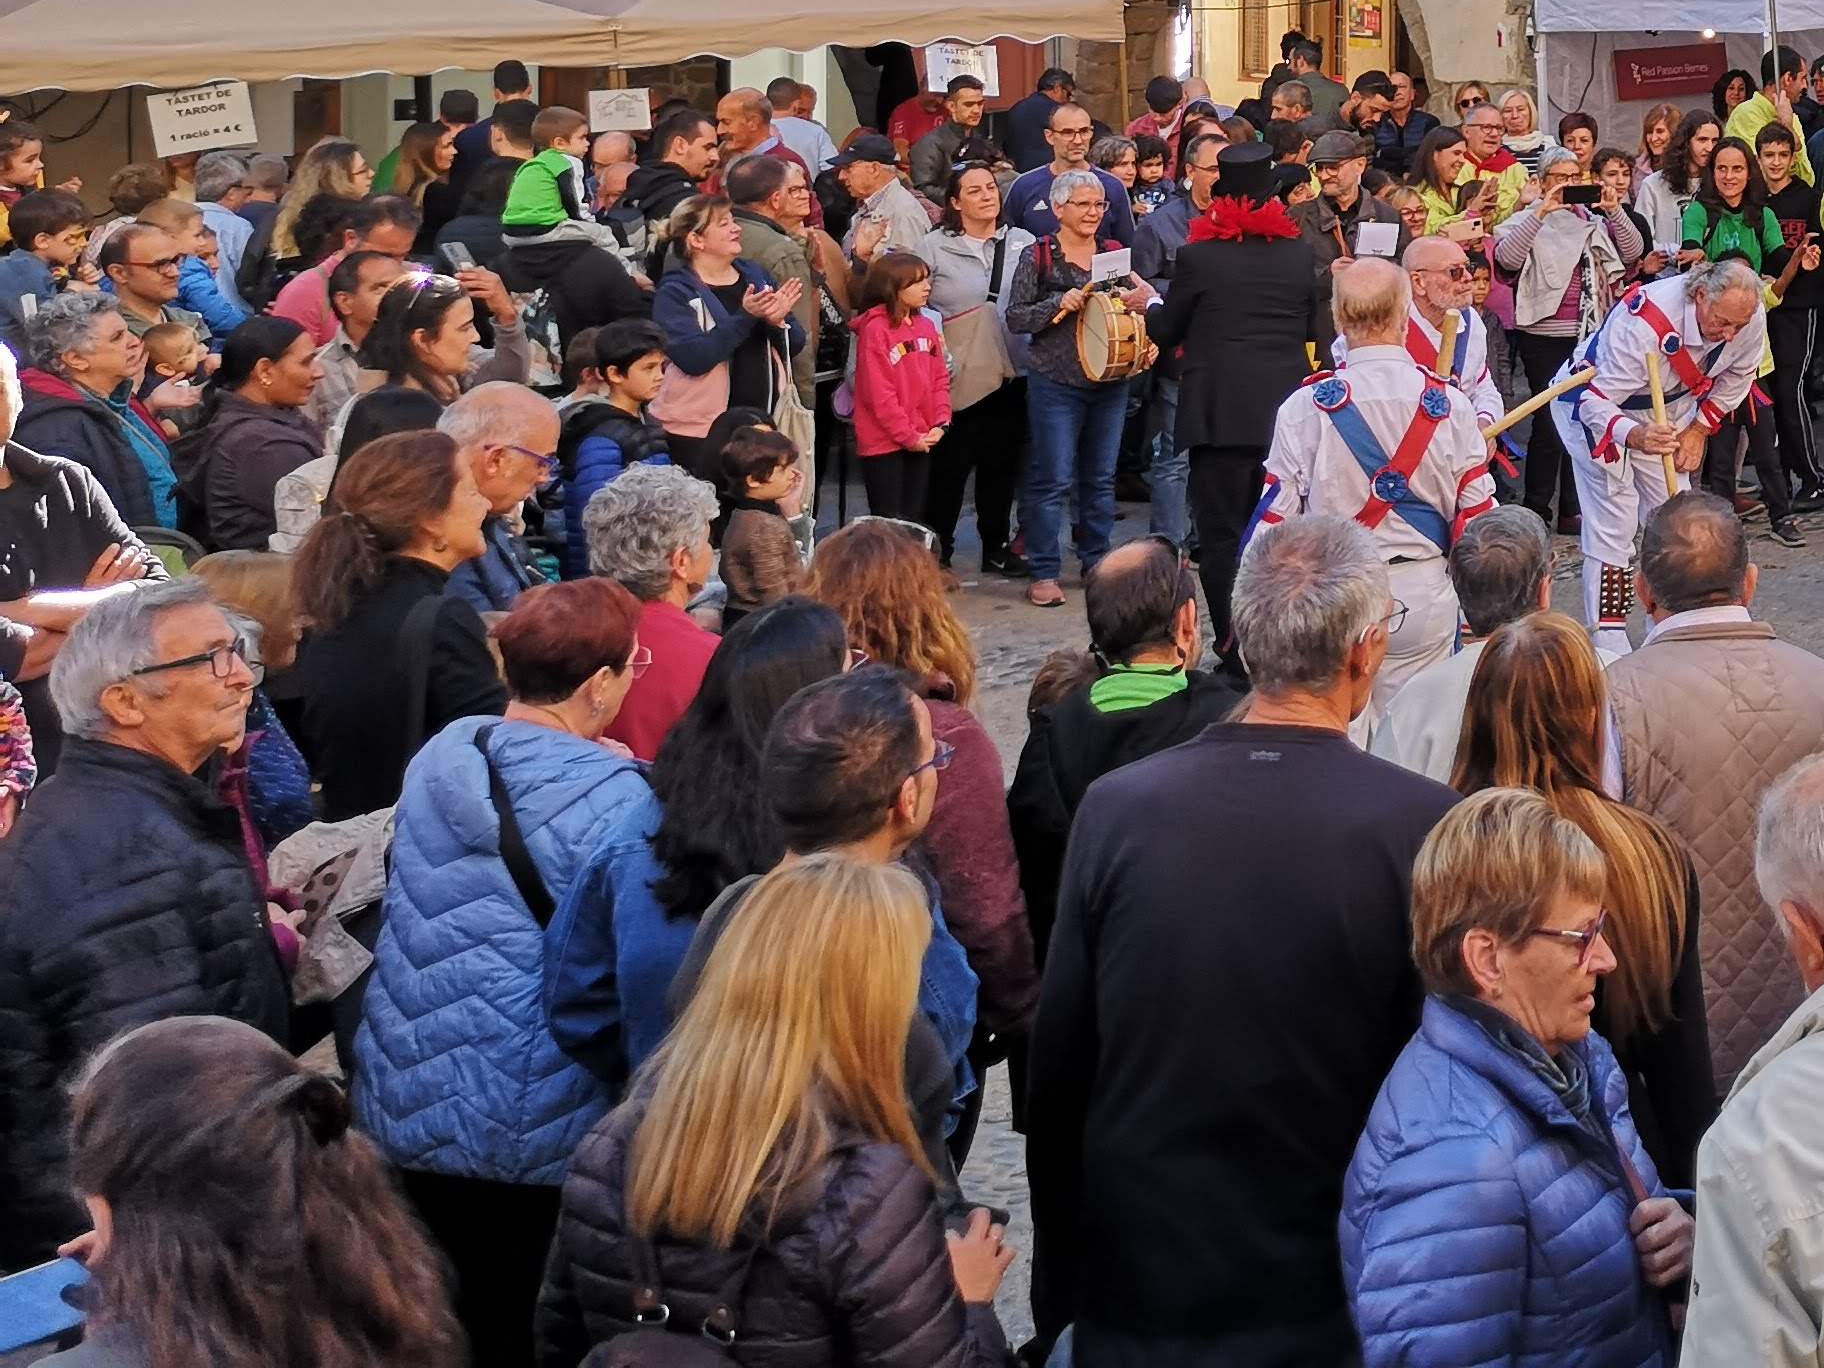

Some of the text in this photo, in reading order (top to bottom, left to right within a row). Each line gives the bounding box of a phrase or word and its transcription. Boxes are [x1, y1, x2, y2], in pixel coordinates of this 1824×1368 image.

[166, 89, 232, 106] TASTET DE
[176, 103, 227, 118] TARDOR
[169, 134, 176, 142] 1
[180, 128, 210, 141] ració
[223, 125, 231, 134] 4
